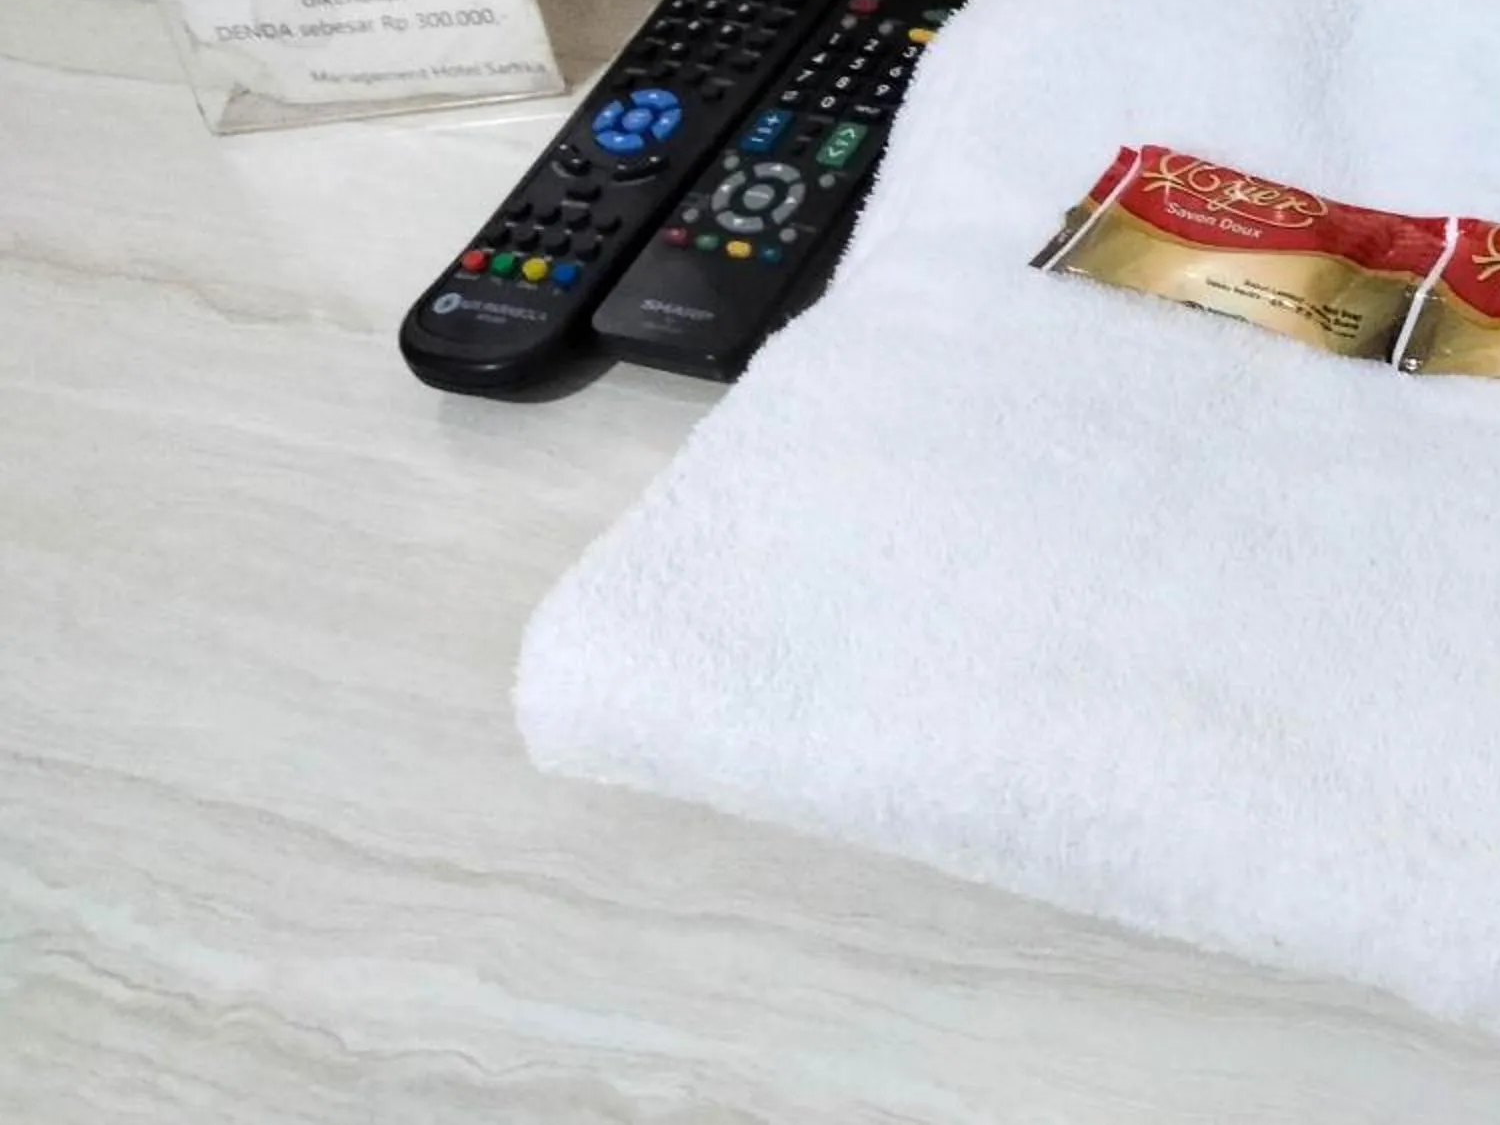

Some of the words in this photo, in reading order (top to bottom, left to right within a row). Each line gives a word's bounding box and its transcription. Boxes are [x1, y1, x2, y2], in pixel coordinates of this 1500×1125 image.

[864, 38, 880, 52] 2
[902, 46, 918, 59] 3
[849, 57, 866, 71] 5
[1165, 201, 1218, 225] Savon
[1217, 217, 1263, 239] Doux
